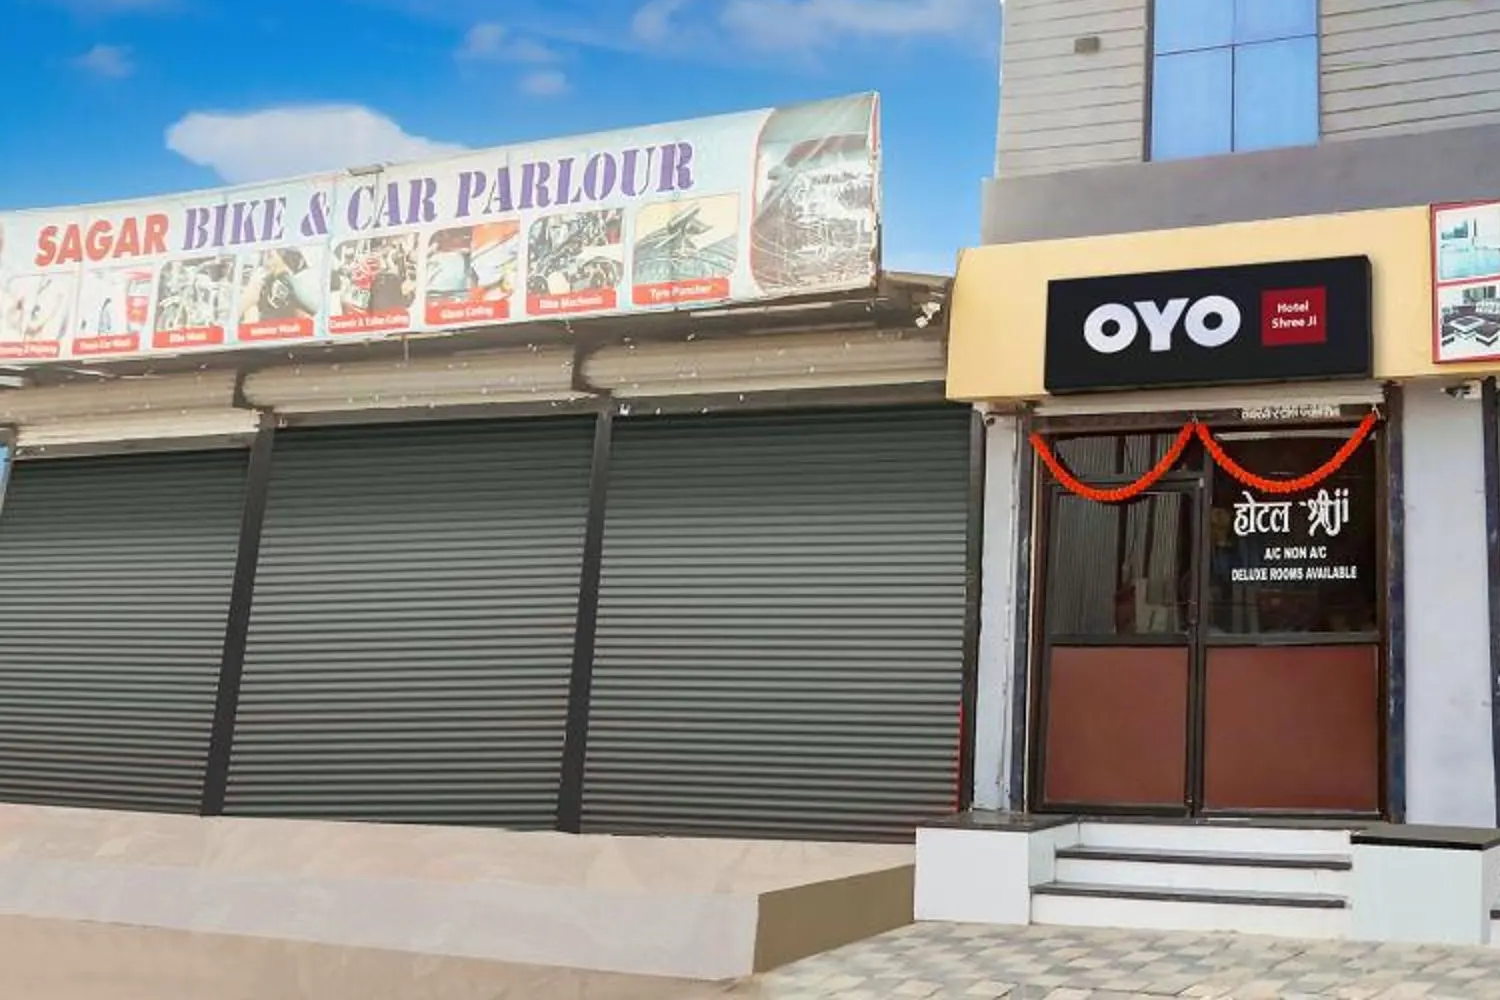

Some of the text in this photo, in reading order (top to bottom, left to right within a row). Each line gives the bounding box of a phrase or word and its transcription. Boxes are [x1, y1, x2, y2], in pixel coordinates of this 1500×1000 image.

[34, 142, 695, 267] SAGAR BIKE & CAR PARLOUR
[1277, 300, 1309, 313] Hotel
[1083, 295, 1241, 354] OYO
[1271, 317, 1306, 329] Shree
[1233, 490, 1292, 536] होटल
[1264, 546, 1327, 560] A/C NON A/C
[1231, 566, 1357, 581] DELUXE ROOMS AVAILABLE
